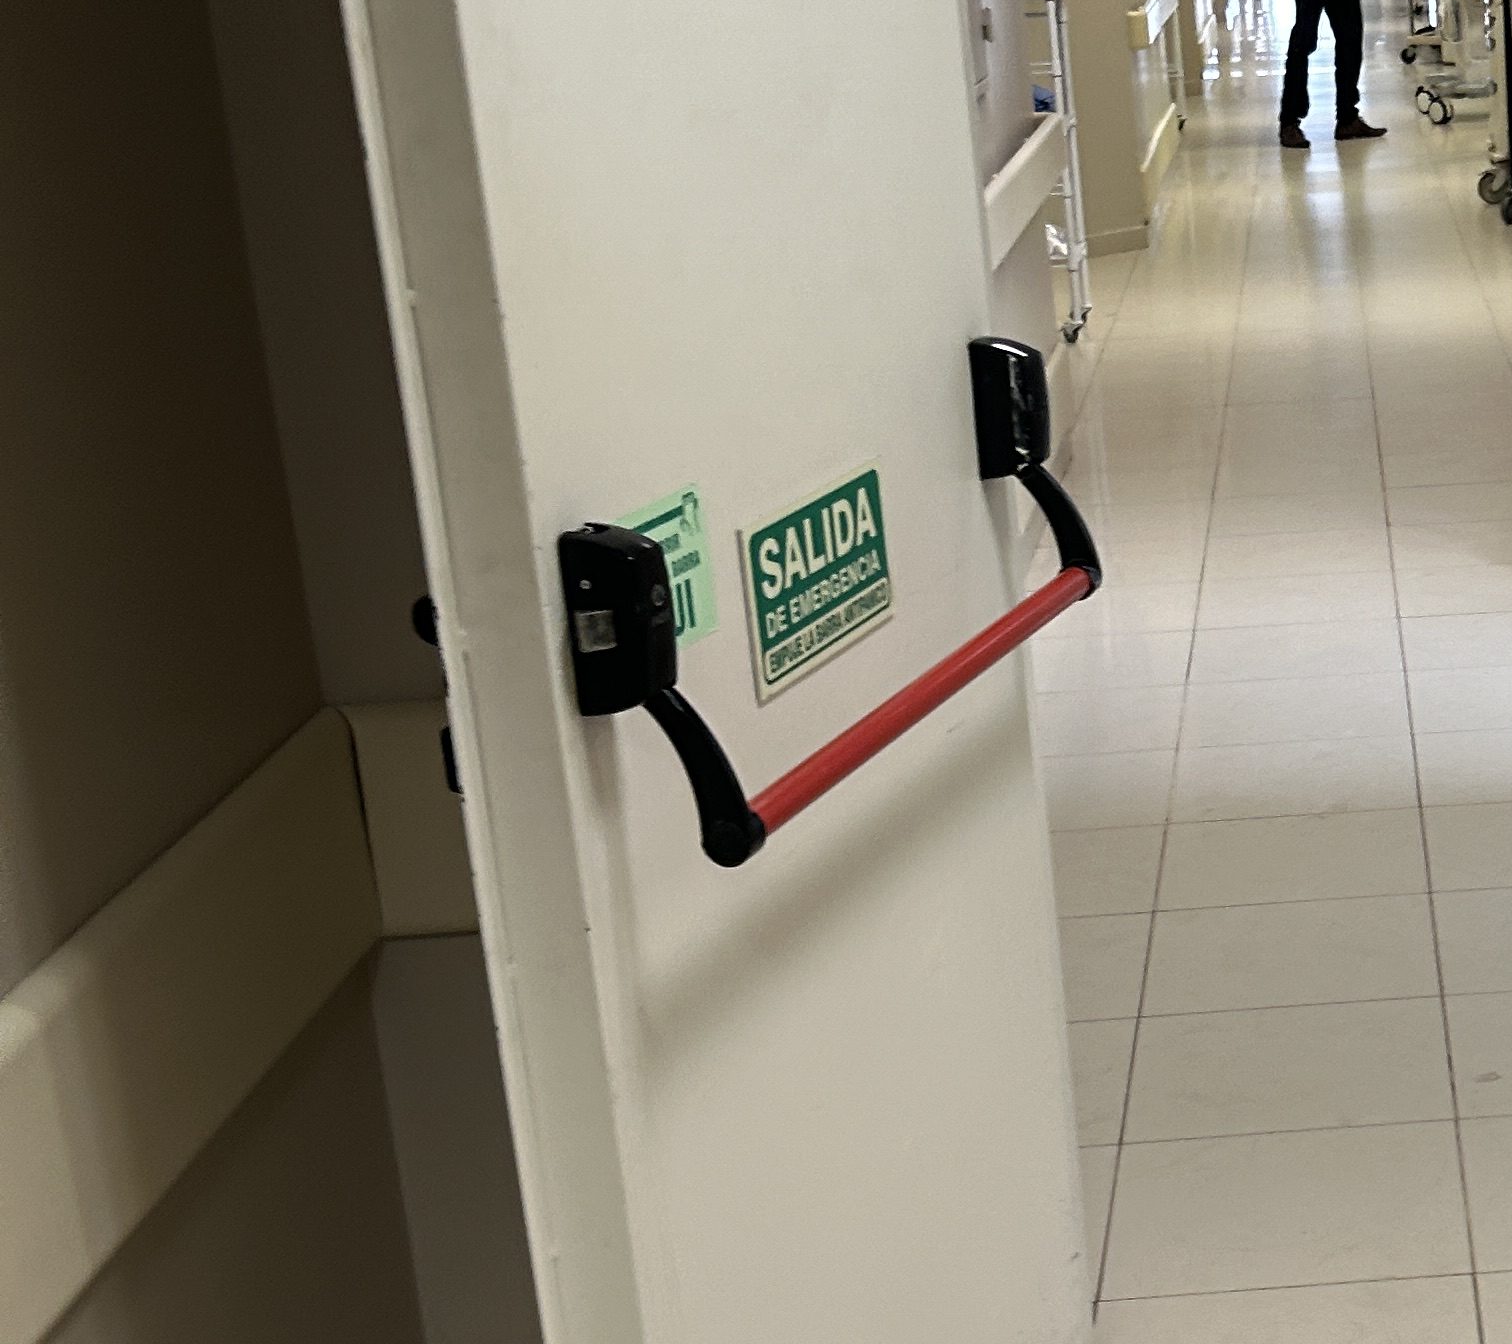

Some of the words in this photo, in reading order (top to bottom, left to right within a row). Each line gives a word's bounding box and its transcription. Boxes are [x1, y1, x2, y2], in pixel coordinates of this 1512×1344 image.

[758, 487, 877, 600] SALIDA
[765, 605, 788, 639] DE
[789, 549, 881, 623] EMERGENCIA
